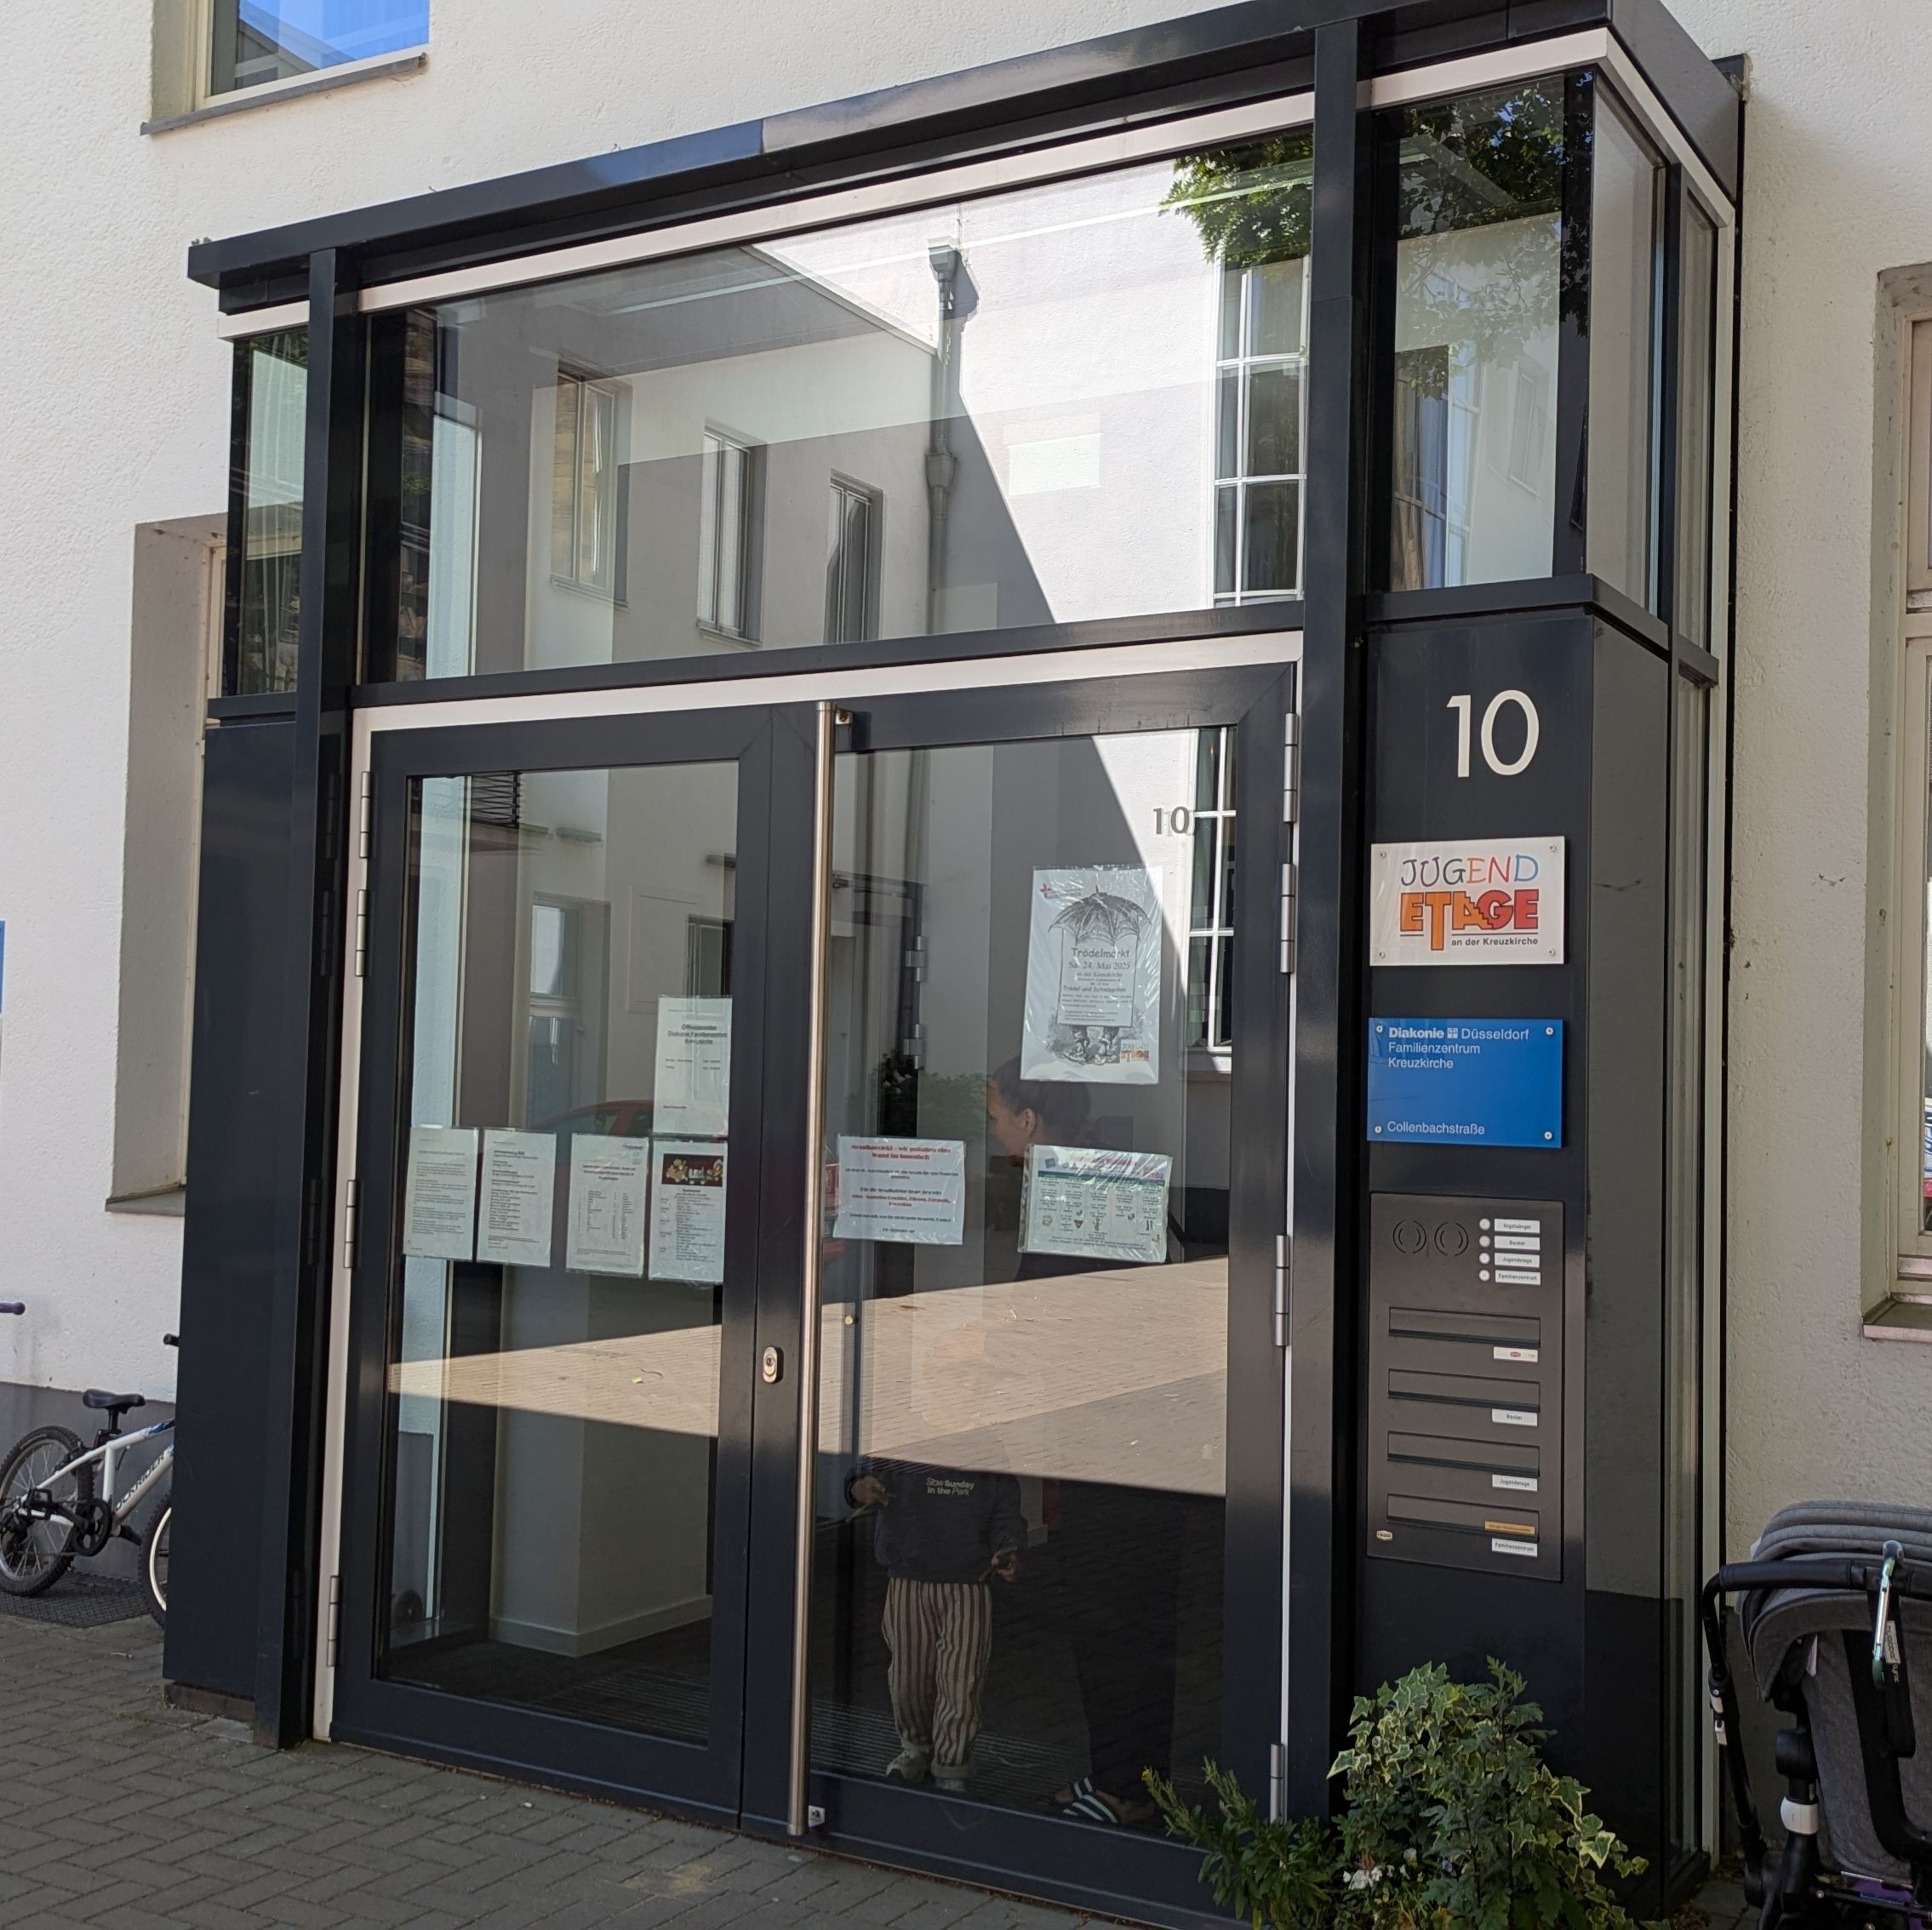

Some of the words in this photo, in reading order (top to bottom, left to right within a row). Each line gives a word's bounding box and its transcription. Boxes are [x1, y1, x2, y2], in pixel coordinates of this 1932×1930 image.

[1446, 689, 1539, 777] 10
[1153, 806, 1190, 835] 10
[1401, 854, 1539, 888] JUGEND
[1400, 889, 1539, 951] ETAGE
[1465, 938, 1480, 946] der
[1483, 937, 1539, 946] Kreuzkirche
[1071, 946, 1130, 958] Trödelmarkt
[1389, 1027, 1444, 1039] Diakonie
[1461, 1028, 1529, 1040] Düsseldorf
[1389, 1042, 1480, 1054] Familienzentrum
[1388, 1057, 1454, 1069] Kreuzkirche
[1387, 1121, 1485, 1135] Collenbachstraße
[944, 1480, 975, 1490] Sunday
